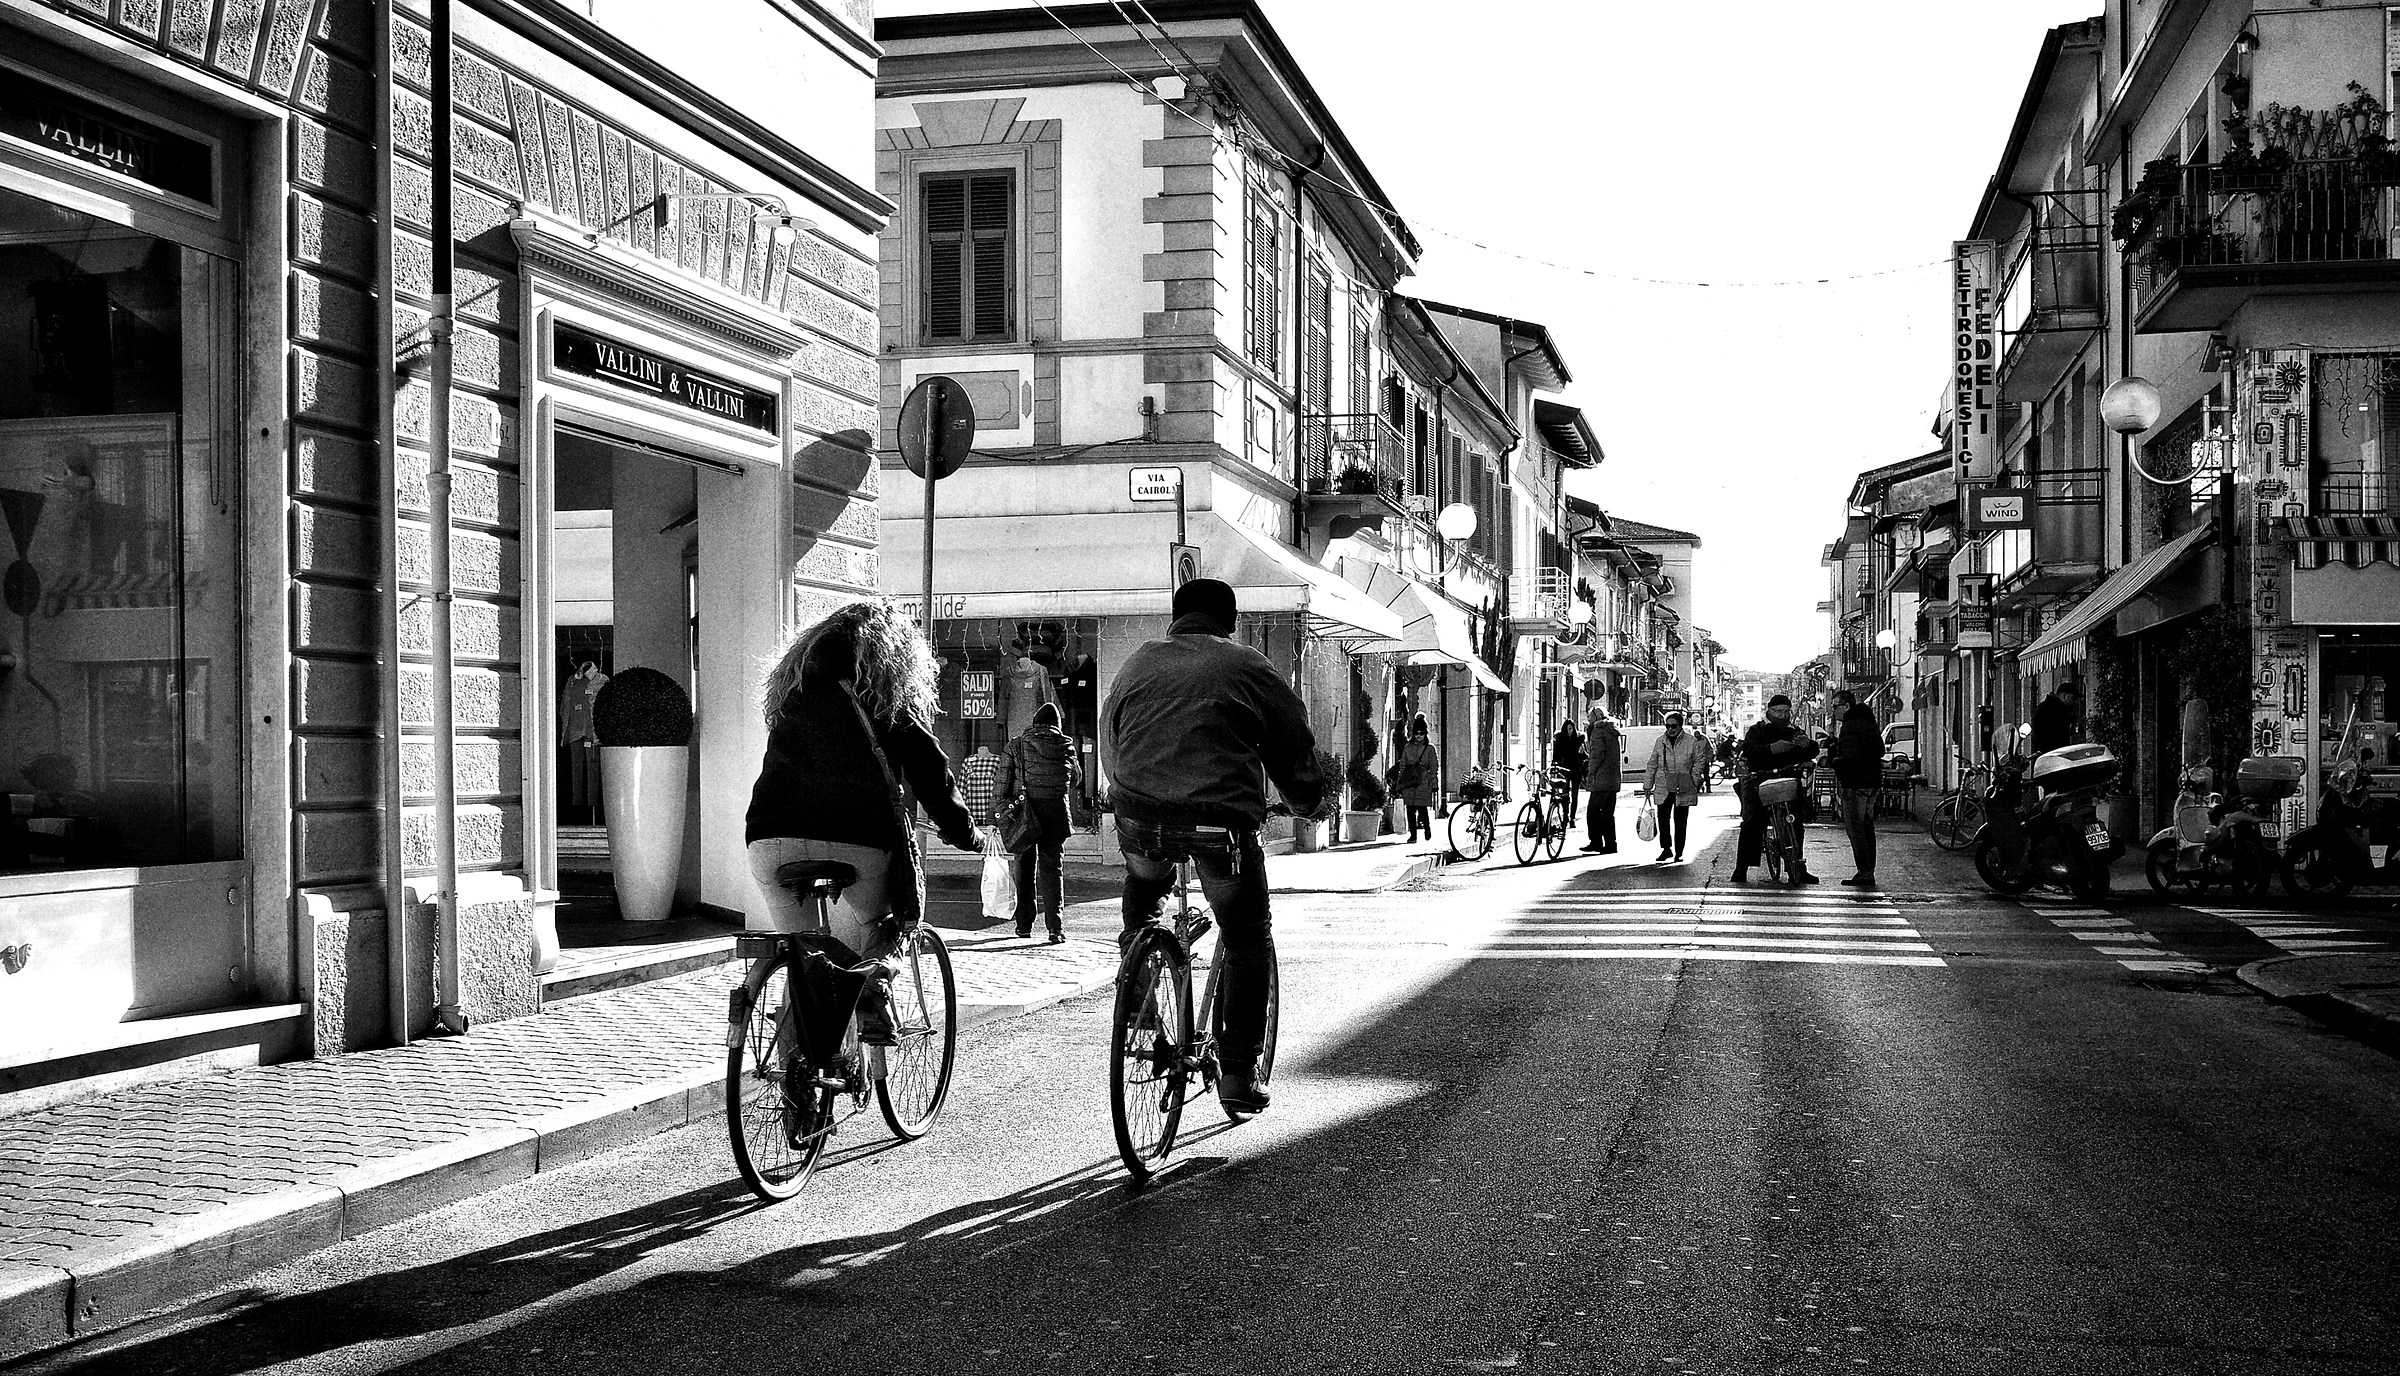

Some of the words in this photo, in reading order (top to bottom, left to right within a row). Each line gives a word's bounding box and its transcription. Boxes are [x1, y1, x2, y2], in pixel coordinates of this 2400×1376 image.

[33, 99, 157, 177] VALLINI
[1957, 244, 1973, 478] ELETTRODOMESTICI
[1975, 288, 1992, 434] FEDELI
[595, 342, 663, 385] VALLINI
[669, 372, 681, 394] &
[687, 381, 745, 419] VALLINI
[1148, 474, 1165, 482] VIA
[1985, 509, 2019, 518] WIND
[1963, 578, 1987, 606] T
[963, 673, 993, 692] SALDI
[963, 699, 992, 716] 50%
